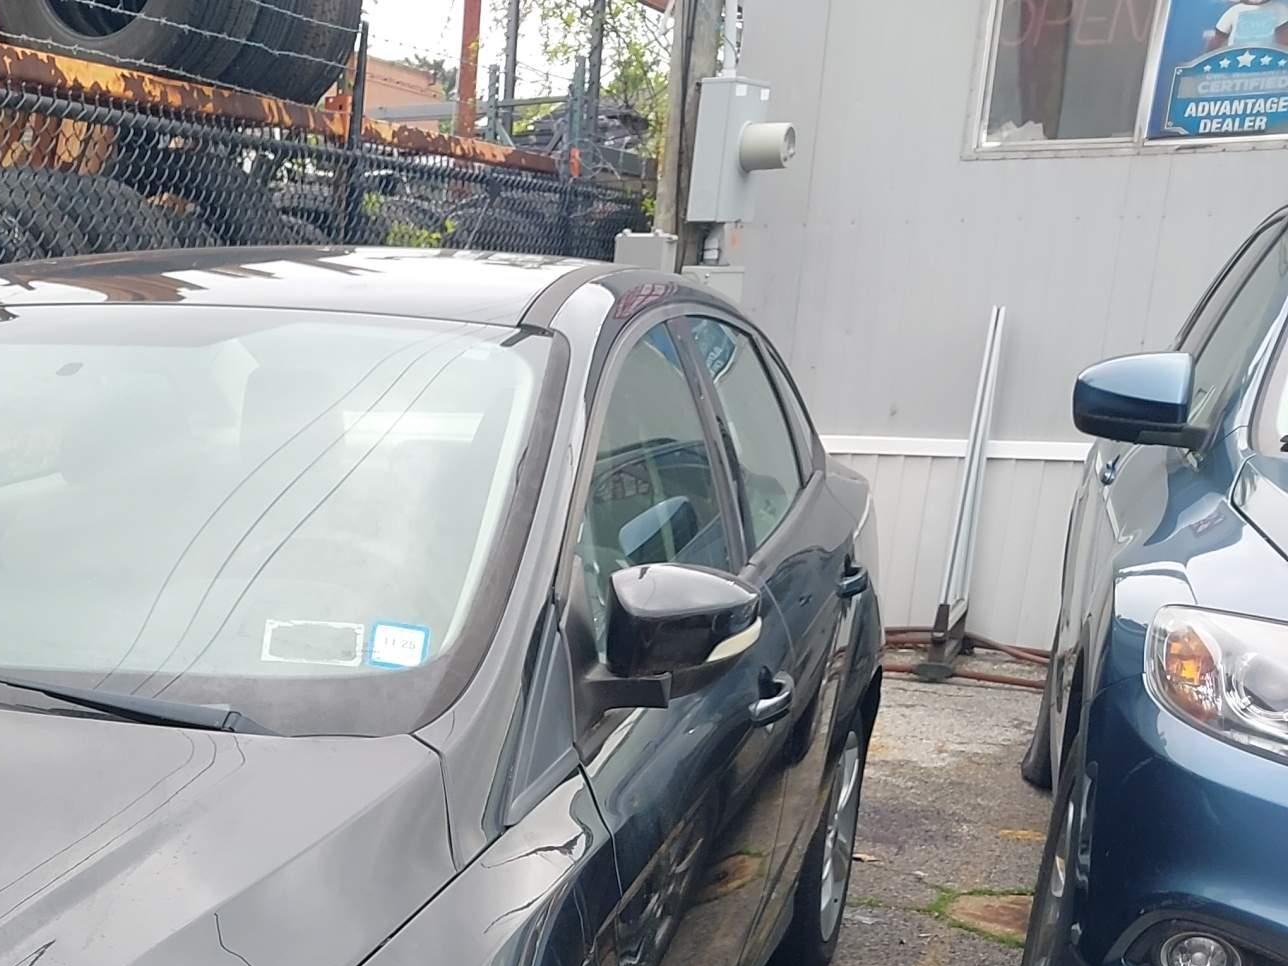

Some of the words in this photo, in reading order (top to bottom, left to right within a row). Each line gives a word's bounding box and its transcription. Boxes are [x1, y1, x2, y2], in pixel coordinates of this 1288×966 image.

[1197, 77, 1288, 94] CERTIFIED
[1184, 96, 1288, 117] ADVANTAGE
[1199, 116, 1267, 133] DEALER
